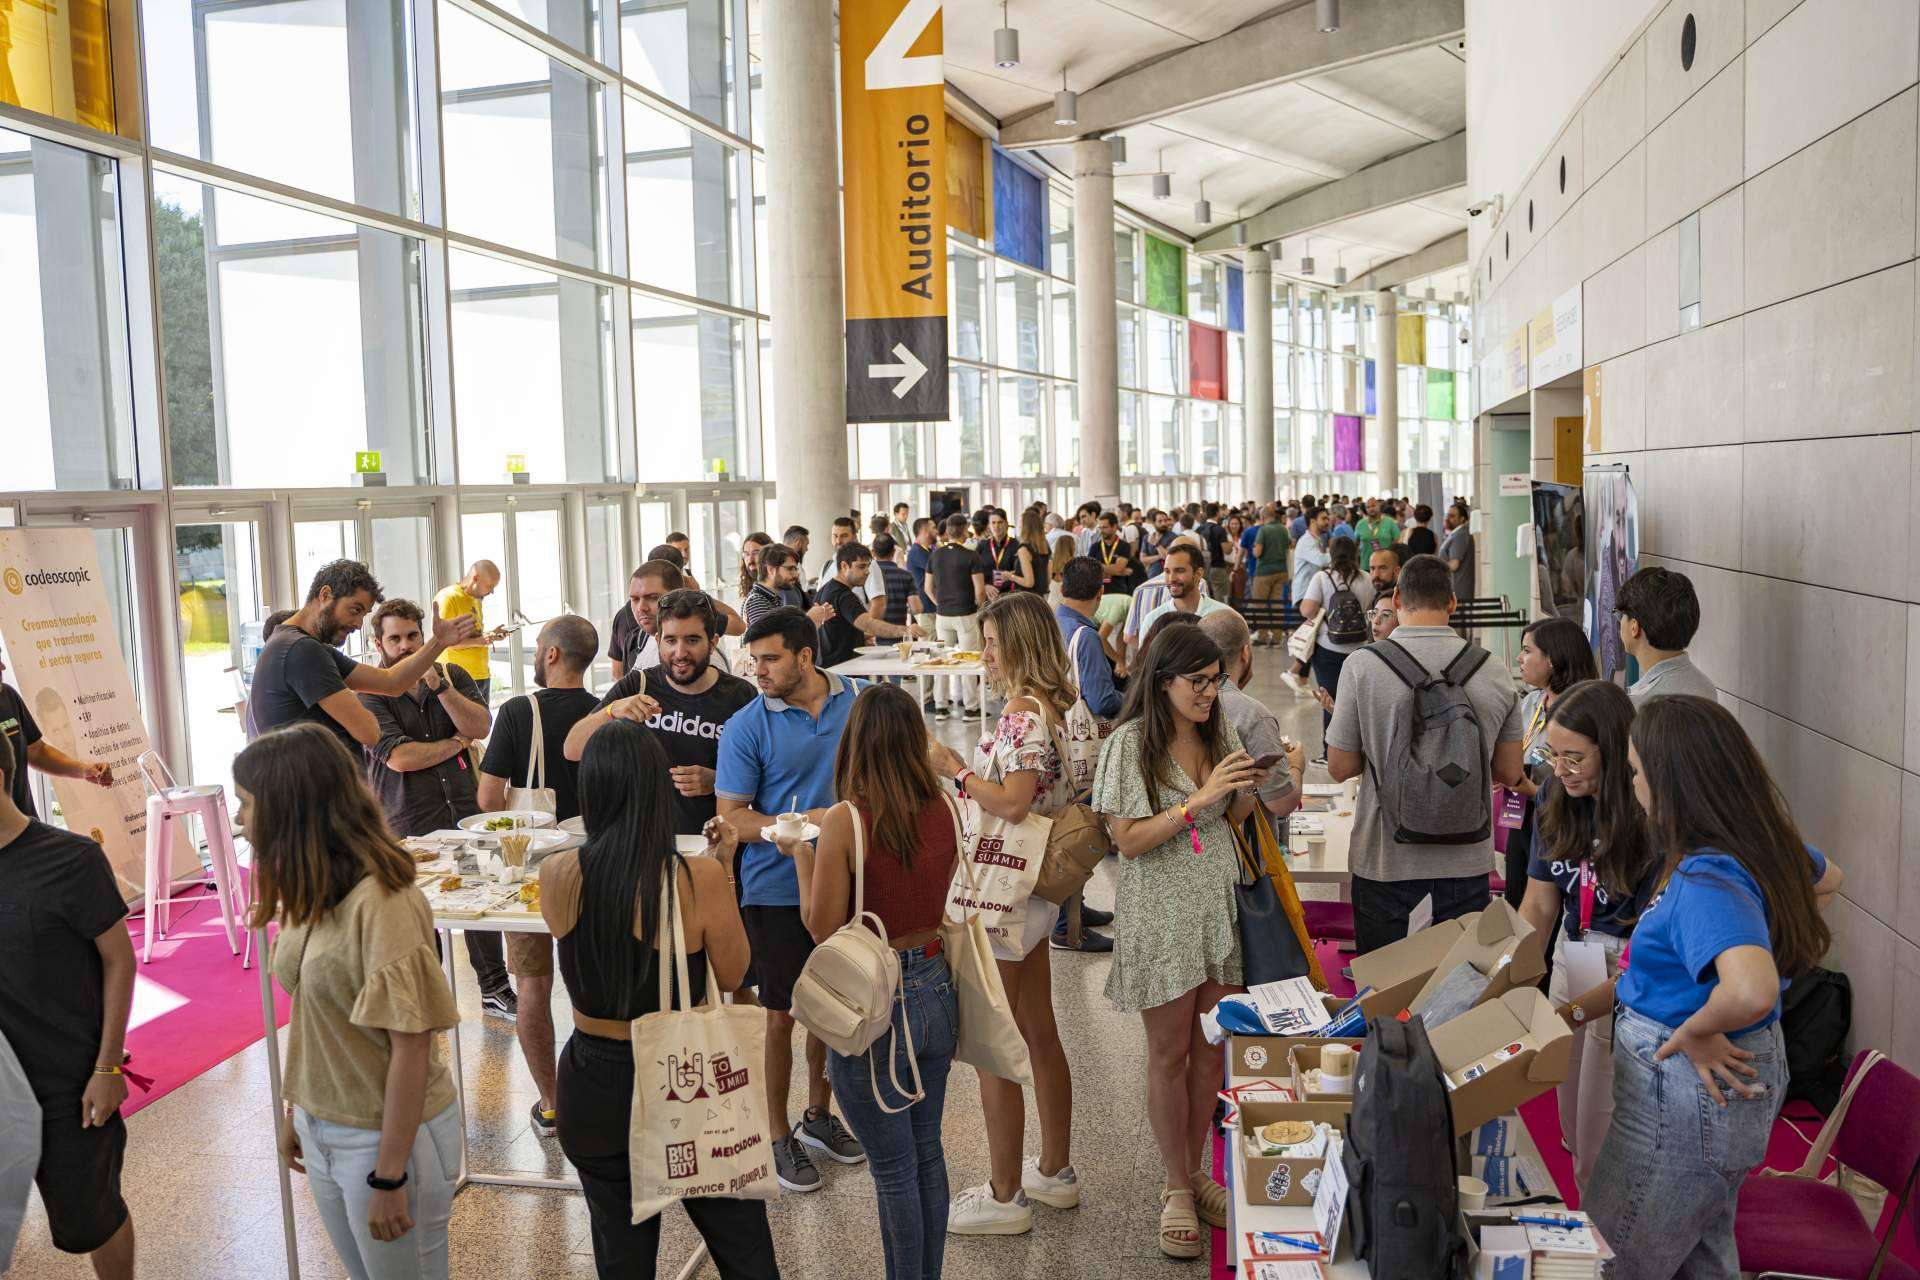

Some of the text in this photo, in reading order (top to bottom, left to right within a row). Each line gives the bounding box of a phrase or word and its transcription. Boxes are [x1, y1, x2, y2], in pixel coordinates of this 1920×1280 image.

[899, 113, 933, 300] Auditorio
[25, 567, 91, 586] codeoscopic
[21, 618, 59, 631] Creamos
[36, 632, 95, 651] que transforma
[39, 650, 103, 668] el sector seguros
[644, 710, 725, 739] adidas
[977, 853, 1025, 868] SUMMIT
[712, 1061, 729, 1074] TO
[717, 1071, 747, 1092] UMMIT
[670, 1161, 696, 1178] BUY
[657, 1183, 725, 1196] aquaservice
